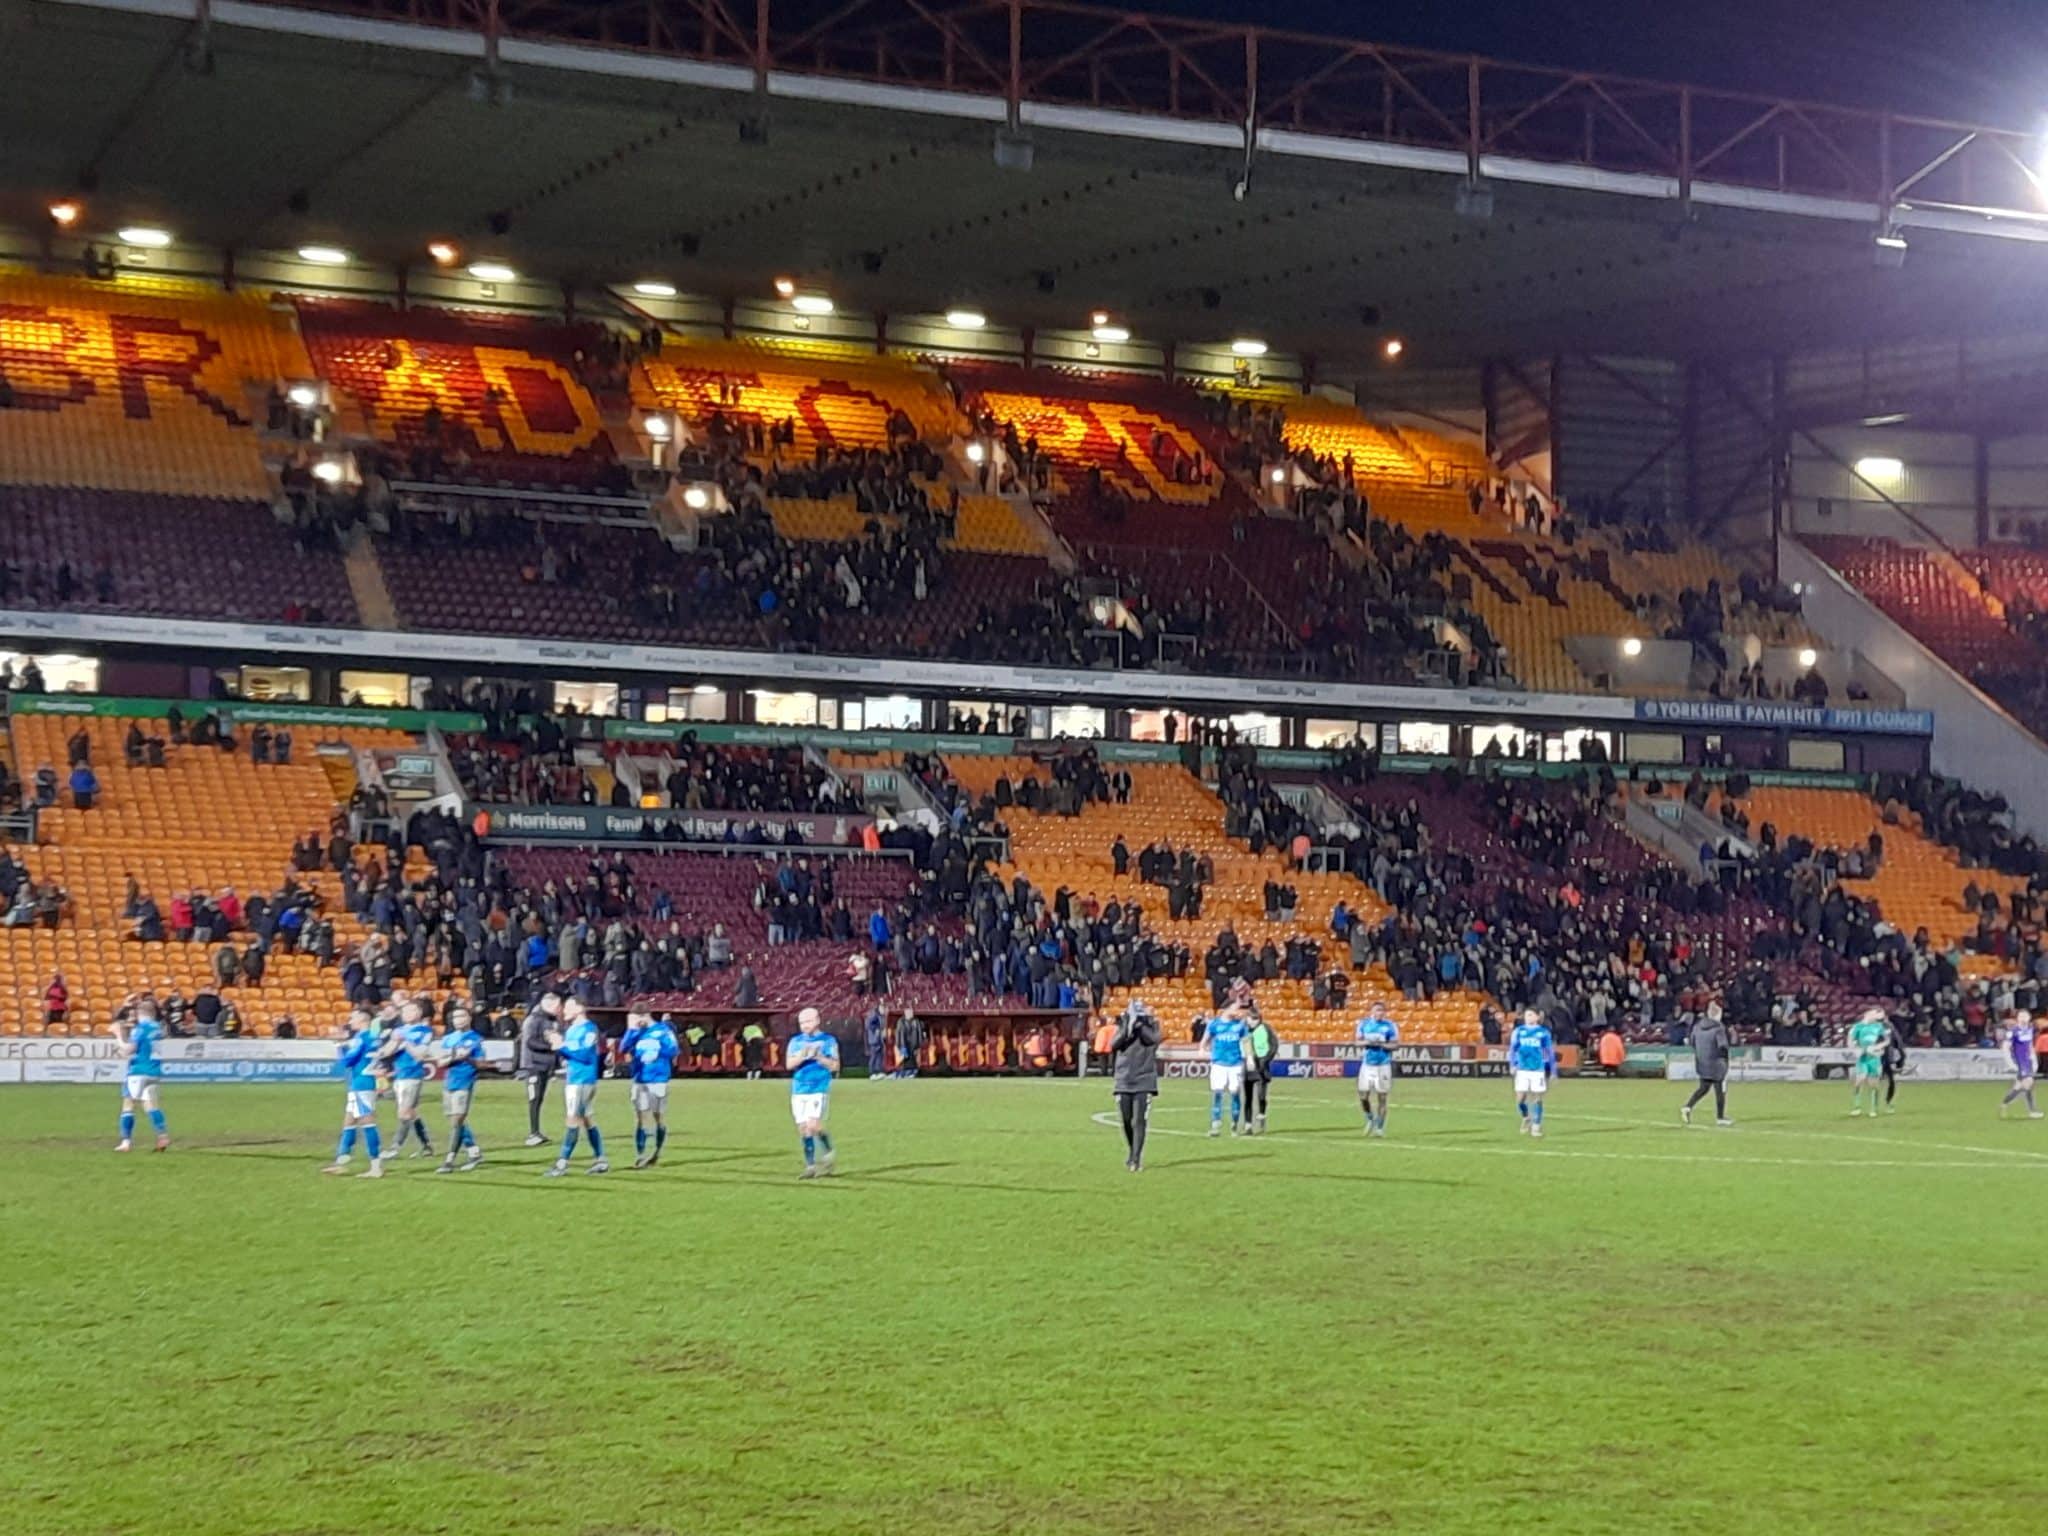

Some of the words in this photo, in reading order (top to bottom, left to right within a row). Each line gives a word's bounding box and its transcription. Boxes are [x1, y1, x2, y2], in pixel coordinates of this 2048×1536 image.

[1659, 701, 1741, 720] YORKSHIRE
[1746, 704, 1821, 725] PAYMENTS
[509, 812, 587, 831] Morrisons
[606, 815, 644, 833] Famil
[161, 1062, 234, 1075] ORKSHIRE
[1288, 1060, 1311, 1078] sky
[1317, 1062, 1343, 1074] bet
[1401, 1064, 1470, 1075] WALTONS
